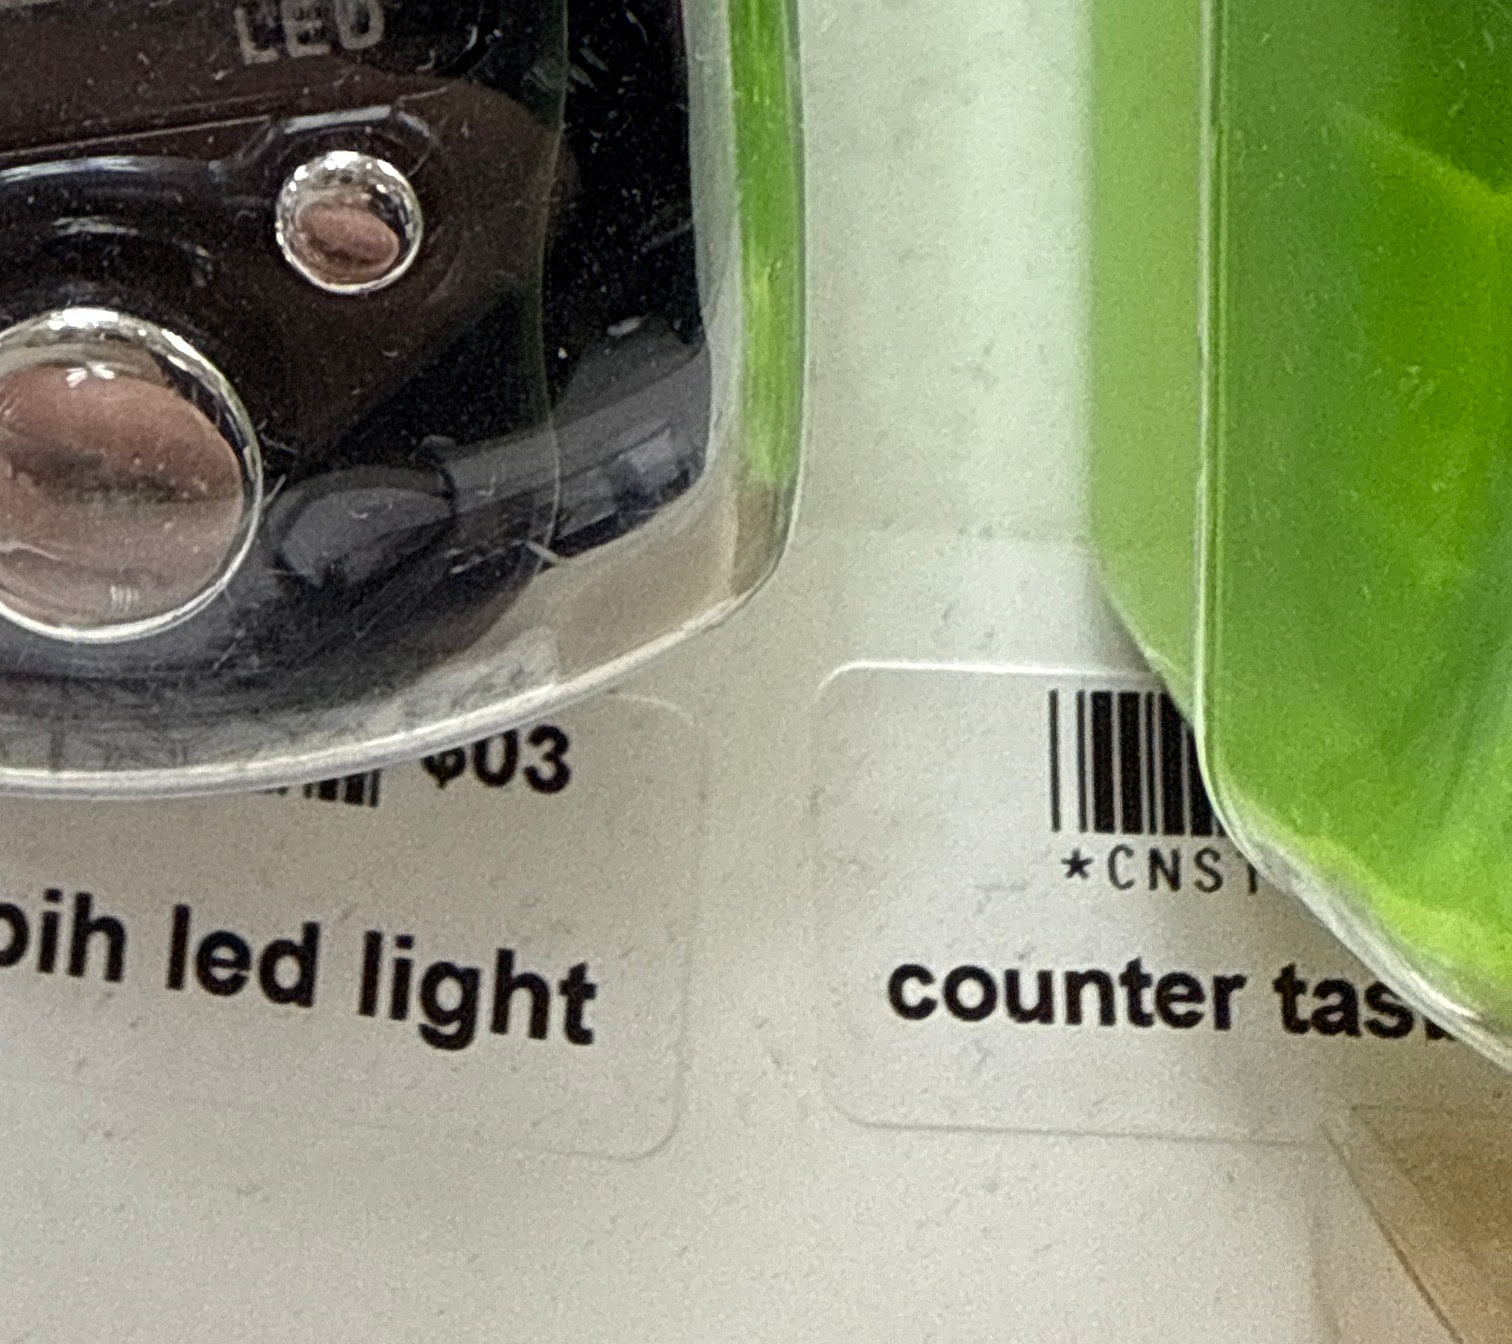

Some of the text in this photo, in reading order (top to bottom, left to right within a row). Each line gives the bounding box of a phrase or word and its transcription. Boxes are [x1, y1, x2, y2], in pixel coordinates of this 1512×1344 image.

[166, 904, 320, 1009] led
[357, 929, 597, 1052] light
[888, 957, 1458, 1041] counter tas
